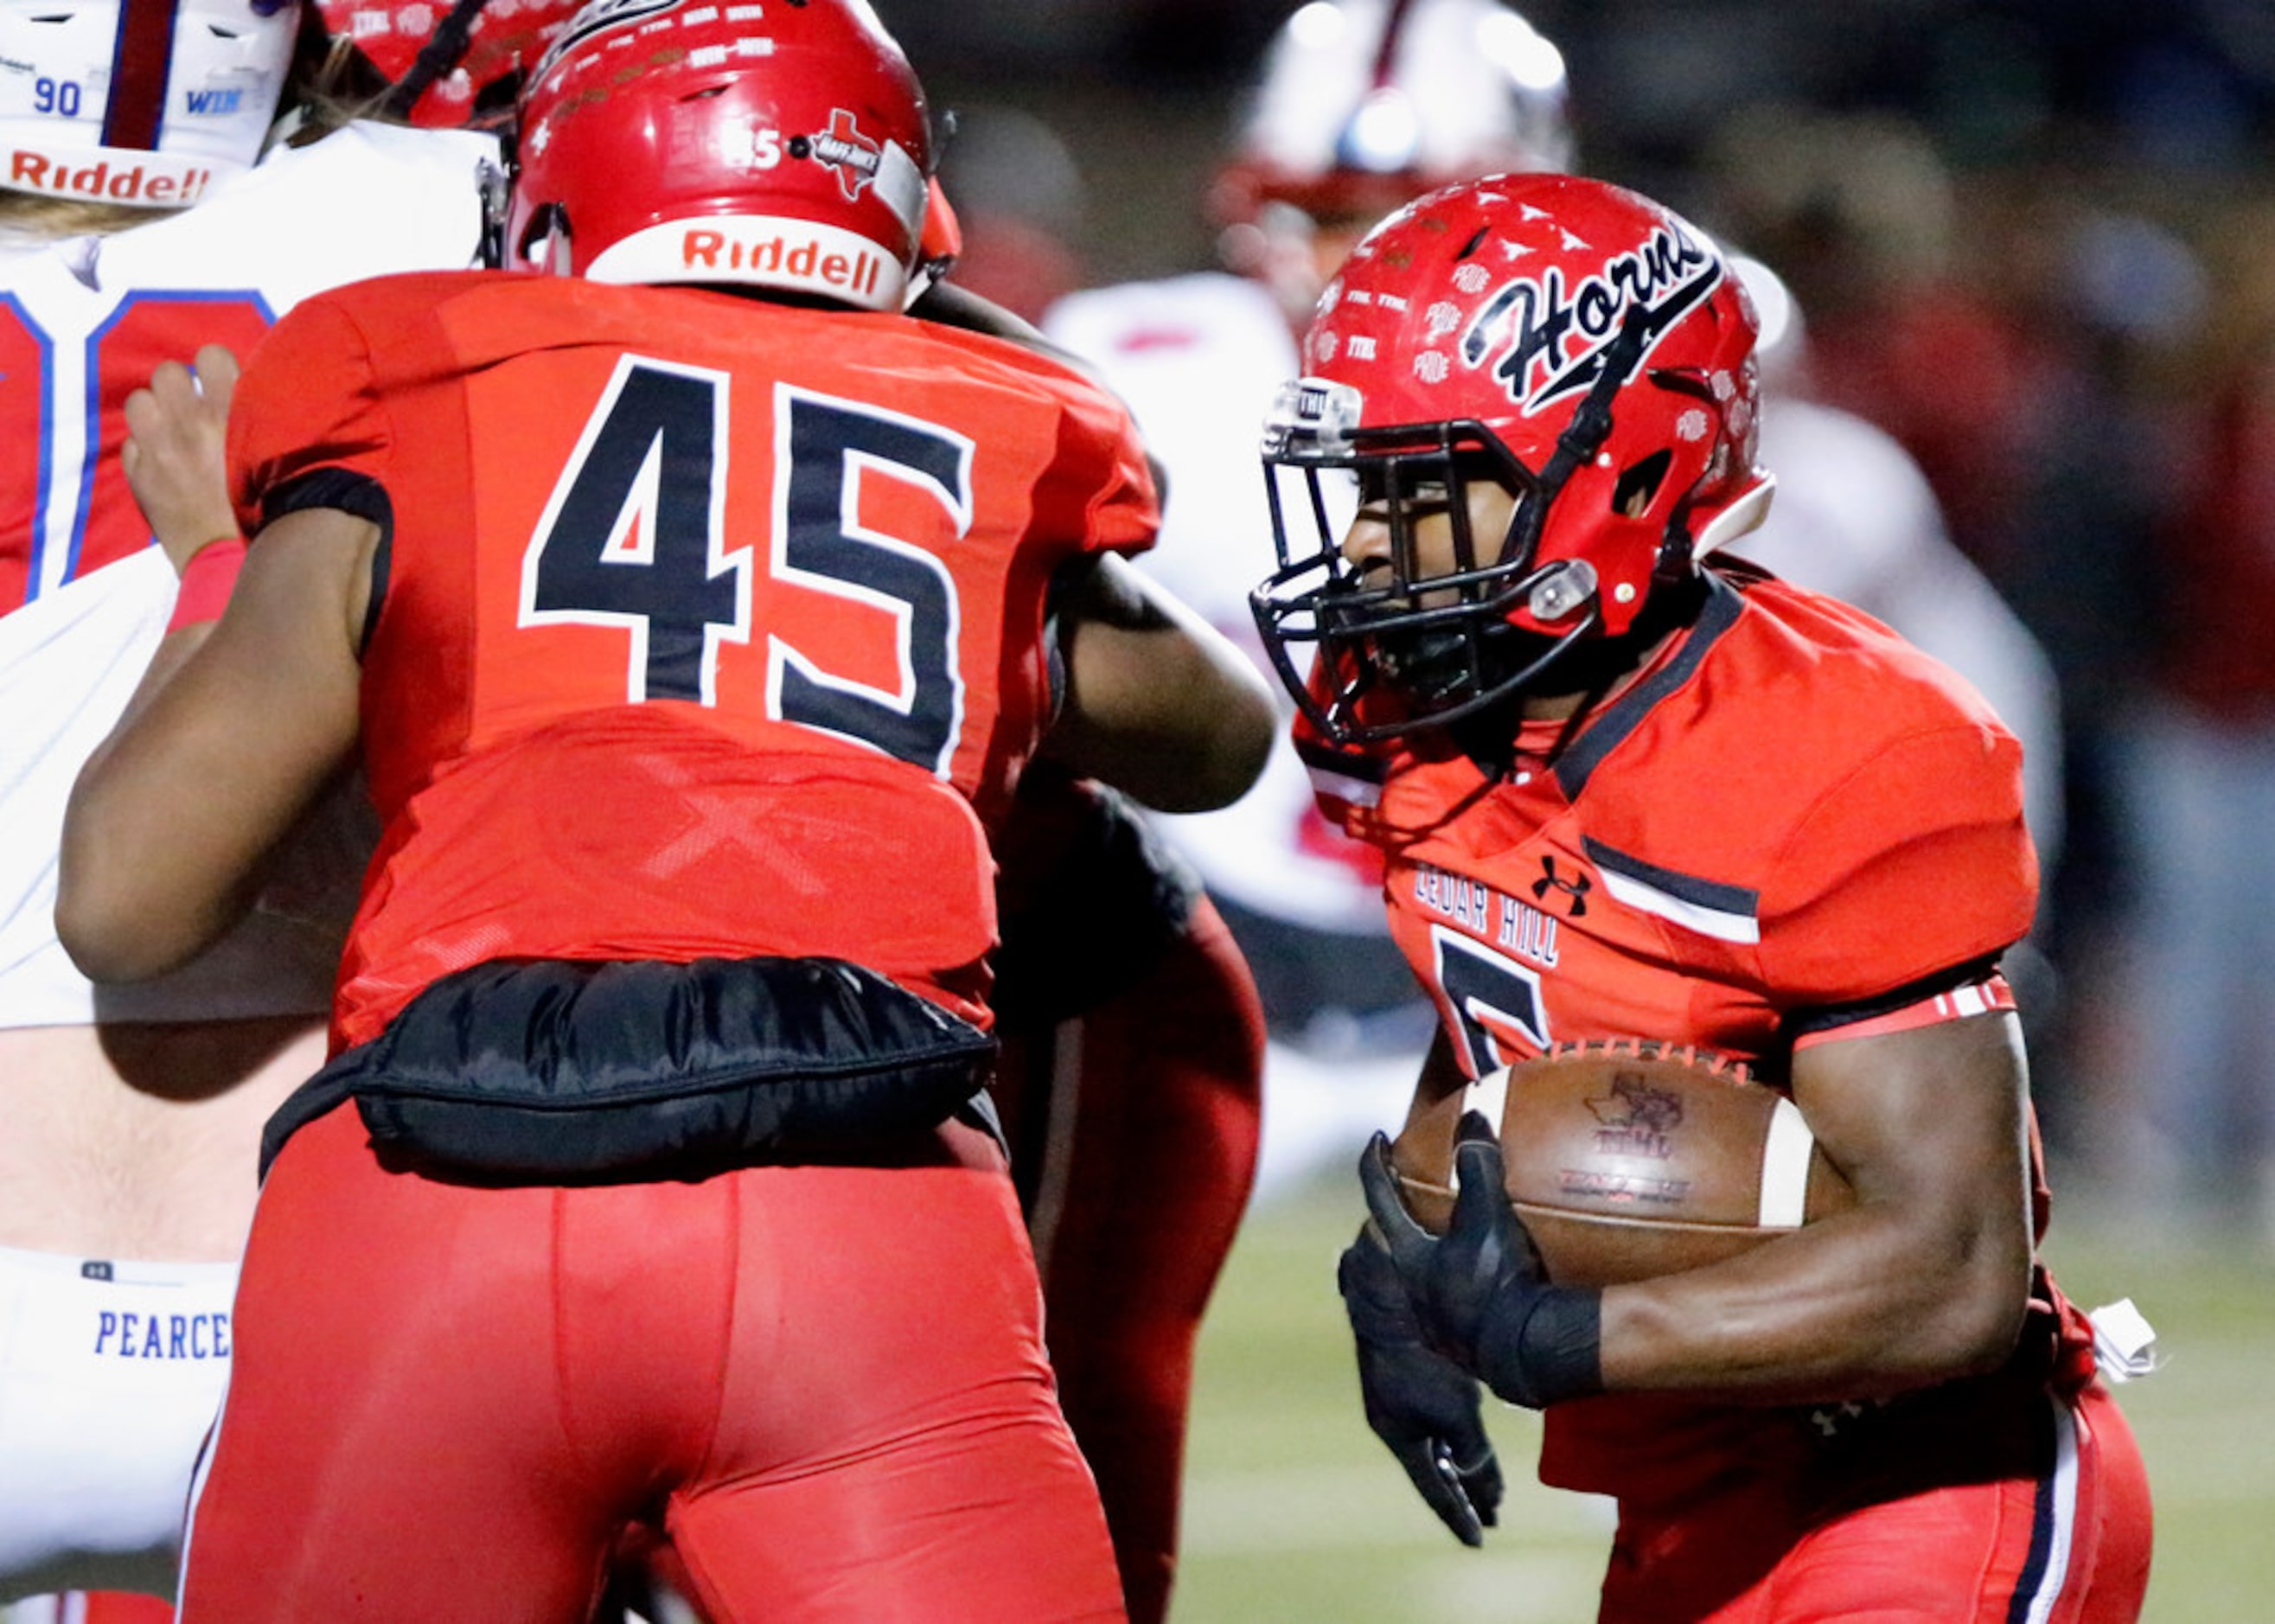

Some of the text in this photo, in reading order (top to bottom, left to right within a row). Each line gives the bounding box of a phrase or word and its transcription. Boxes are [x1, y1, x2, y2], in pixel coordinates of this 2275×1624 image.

[35, 77, 80, 117] 90
[187, 89, 242, 114] WIN
[11, 150, 209, 201] Riddell
[682, 229, 880, 295] Riddell
[1460, 214, 1722, 405] Horns
[518, 353, 975, 783] 45
[1498, 892, 1559, 969] HILL
[93, 1311, 229, 1359] PEARCE
